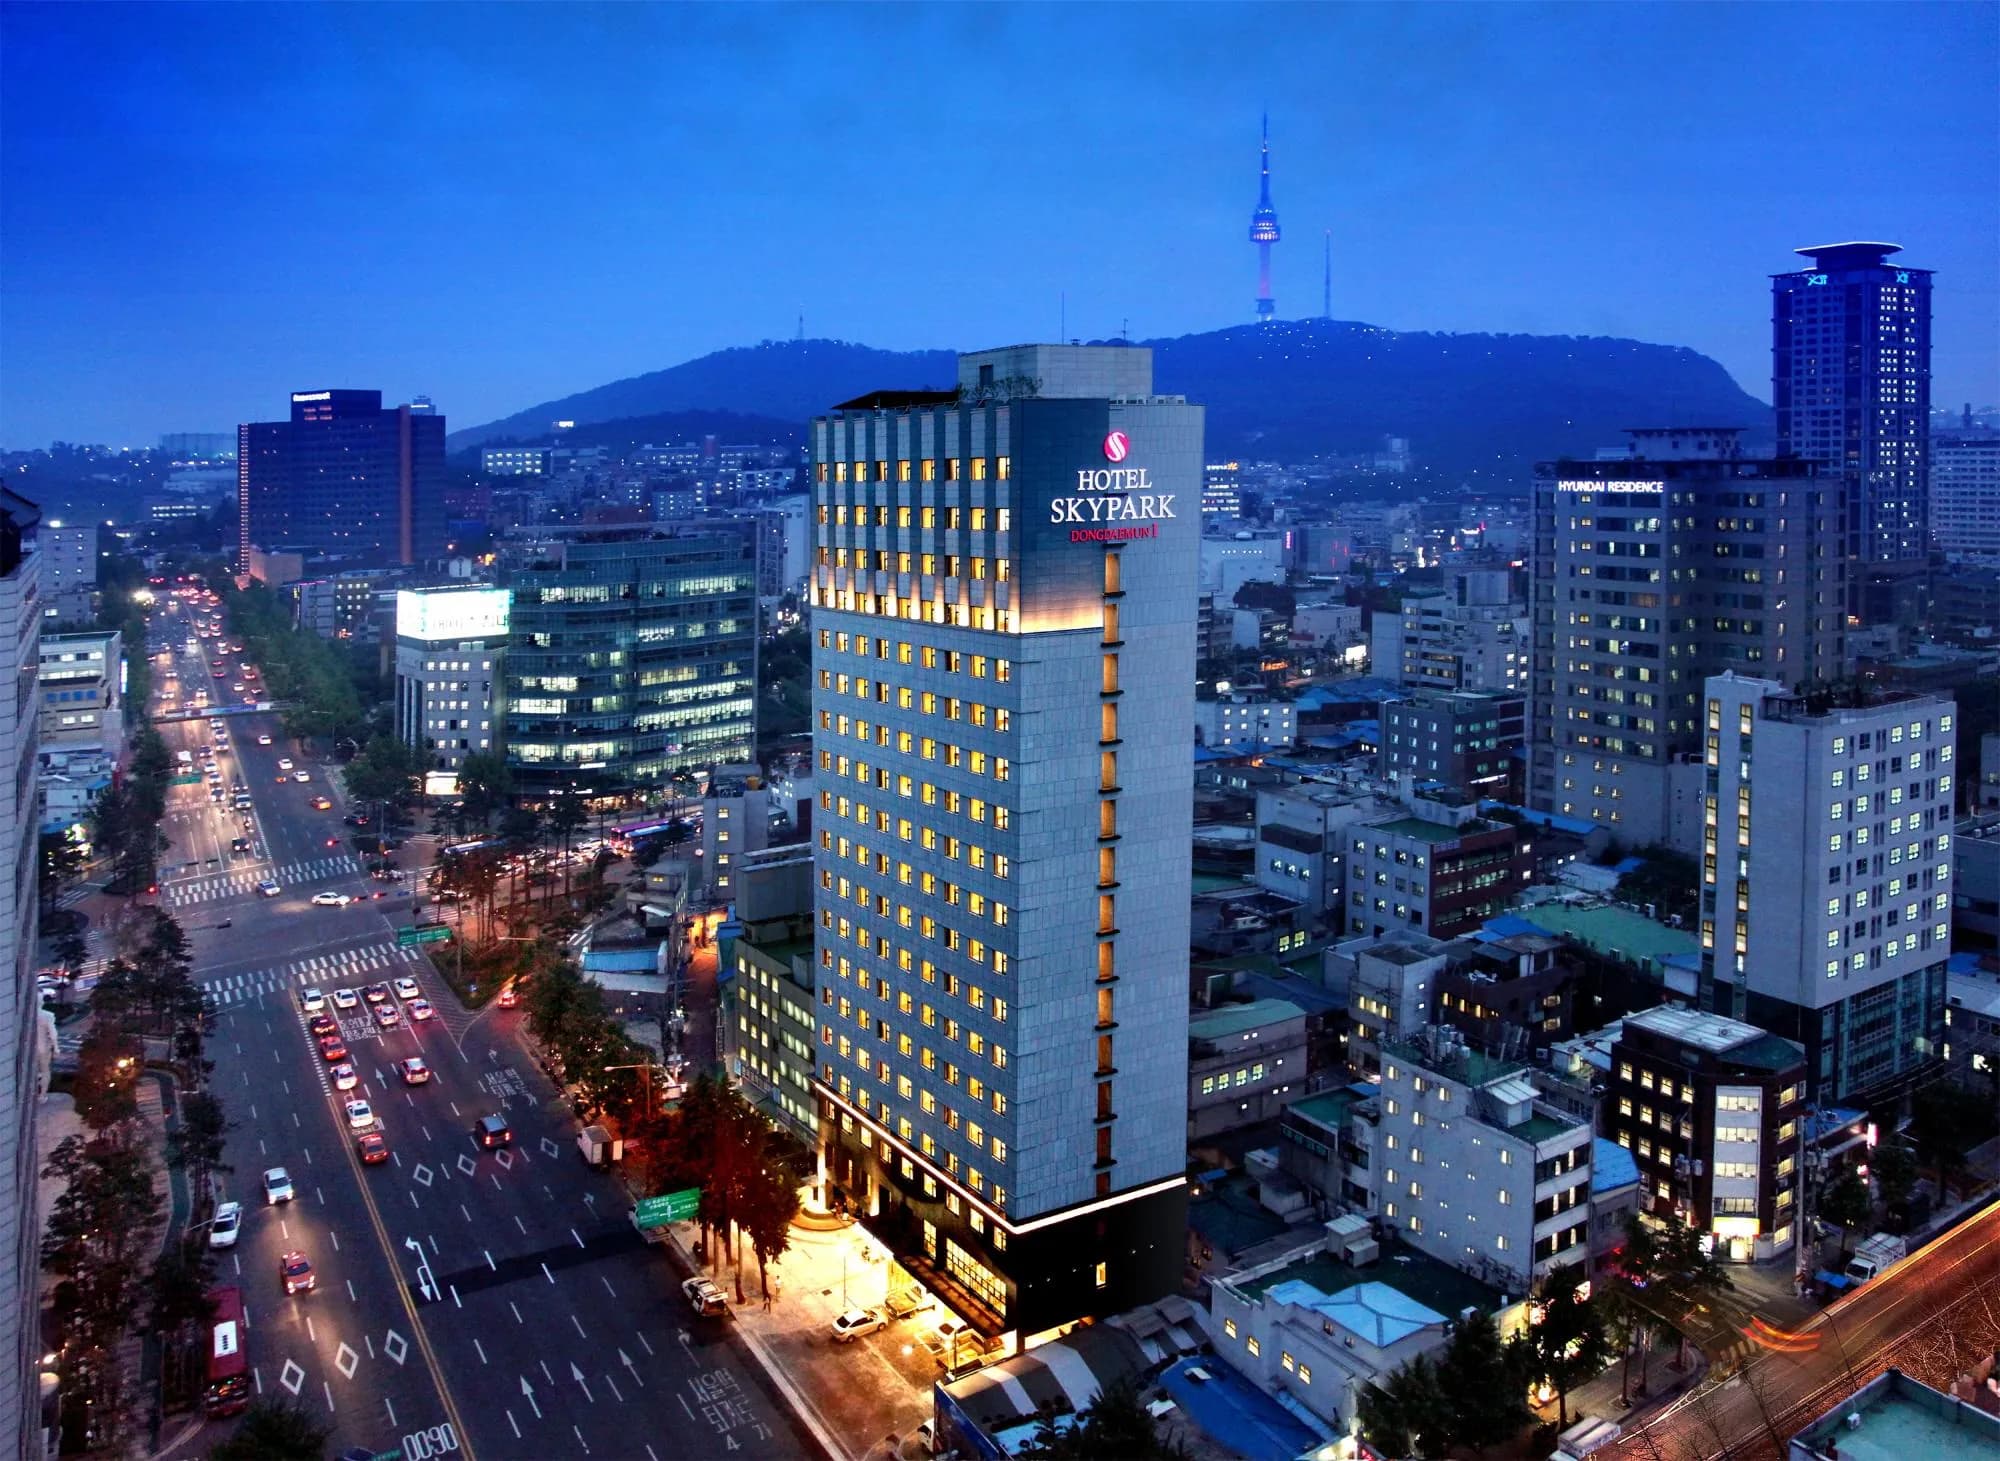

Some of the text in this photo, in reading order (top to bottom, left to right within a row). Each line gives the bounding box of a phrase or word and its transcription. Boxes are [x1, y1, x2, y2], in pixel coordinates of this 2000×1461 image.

[1077, 468, 1152, 491] HOTEL
[1558, 480, 1664, 493] HYUNDAI RESIDENCE
[1050, 495, 1176, 524] SKYPARK
[1071, 527, 1151, 542] DONGDAEMUN
